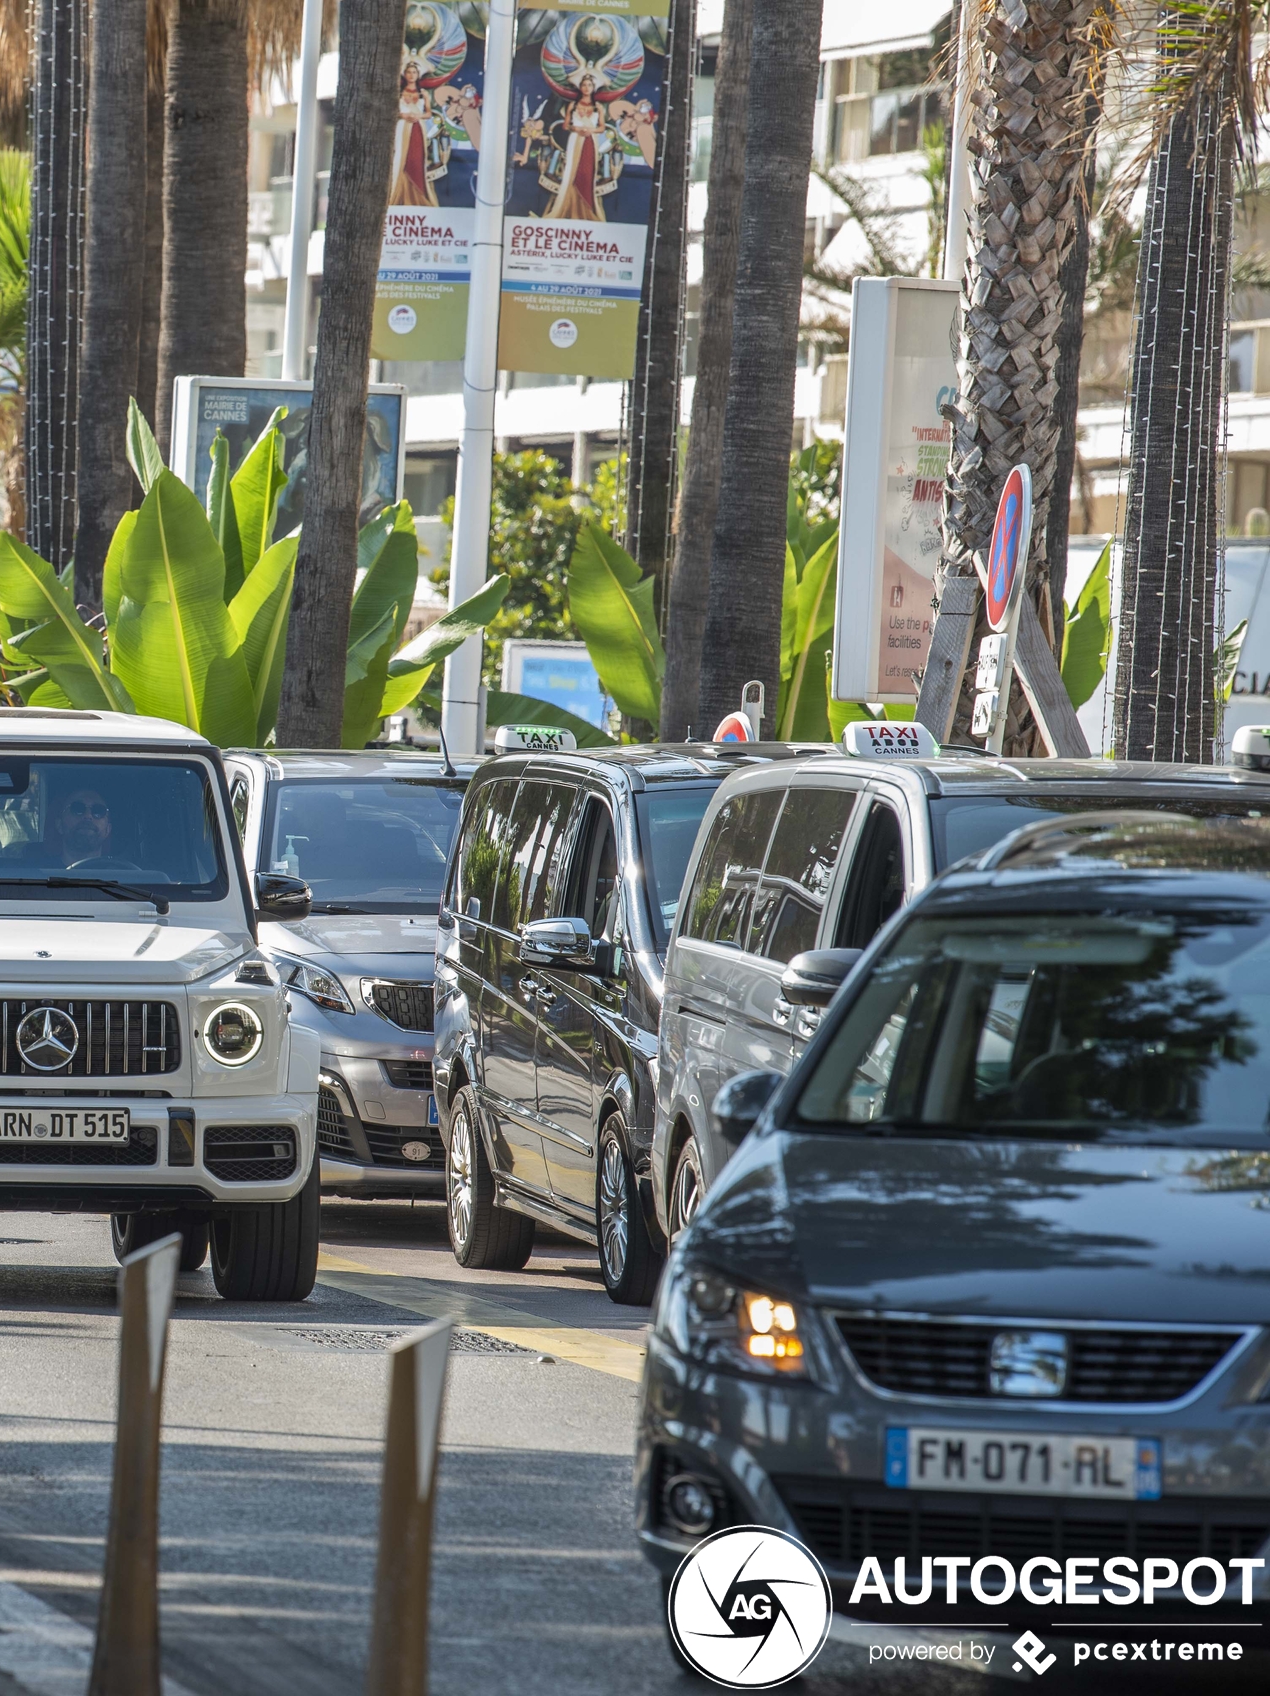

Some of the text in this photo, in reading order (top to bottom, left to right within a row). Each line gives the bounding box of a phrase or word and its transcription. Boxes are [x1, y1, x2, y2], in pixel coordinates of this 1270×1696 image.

[512, 225, 593, 241] GOSCINNY
[417, 239, 439, 247] LUKE
[454, 240, 469, 248] CIE
[511, 237, 530, 249] ET
[535, 239, 553, 250] LE
[550, 252, 579, 260] LUCKY
[619, 256, 634, 264] CIE
[421, 273, 439, 281] 2021
[405, 292, 440, 300] FESTIVALS
[584, 288, 602, 296] 2021
[526, 303, 550, 311] PALAIS
[566, 306, 603, 315] FESTIVALS
[205, 401, 248, 411] MAIRIE DE
[204, 410, 247, 422] CANNES
[917, 458, 947, 477] STRON
[912, 479, 944, 502] ANTIS
[889, 616, 905, 630] Use
[906, 616, 921, 630] the
[887, 634, 922, 649] facilities
[885, 665, 901, 677] Let's
[517, 732, 564, 746] TAXI
[862, 727, 918, 739] TAXI
[526, 742, 559, 751] CANNES
[875, 747, 920, 755] CANNES
[50, 1113, 78, 1138] DT
[84, 1113, 125, 1138] 515
